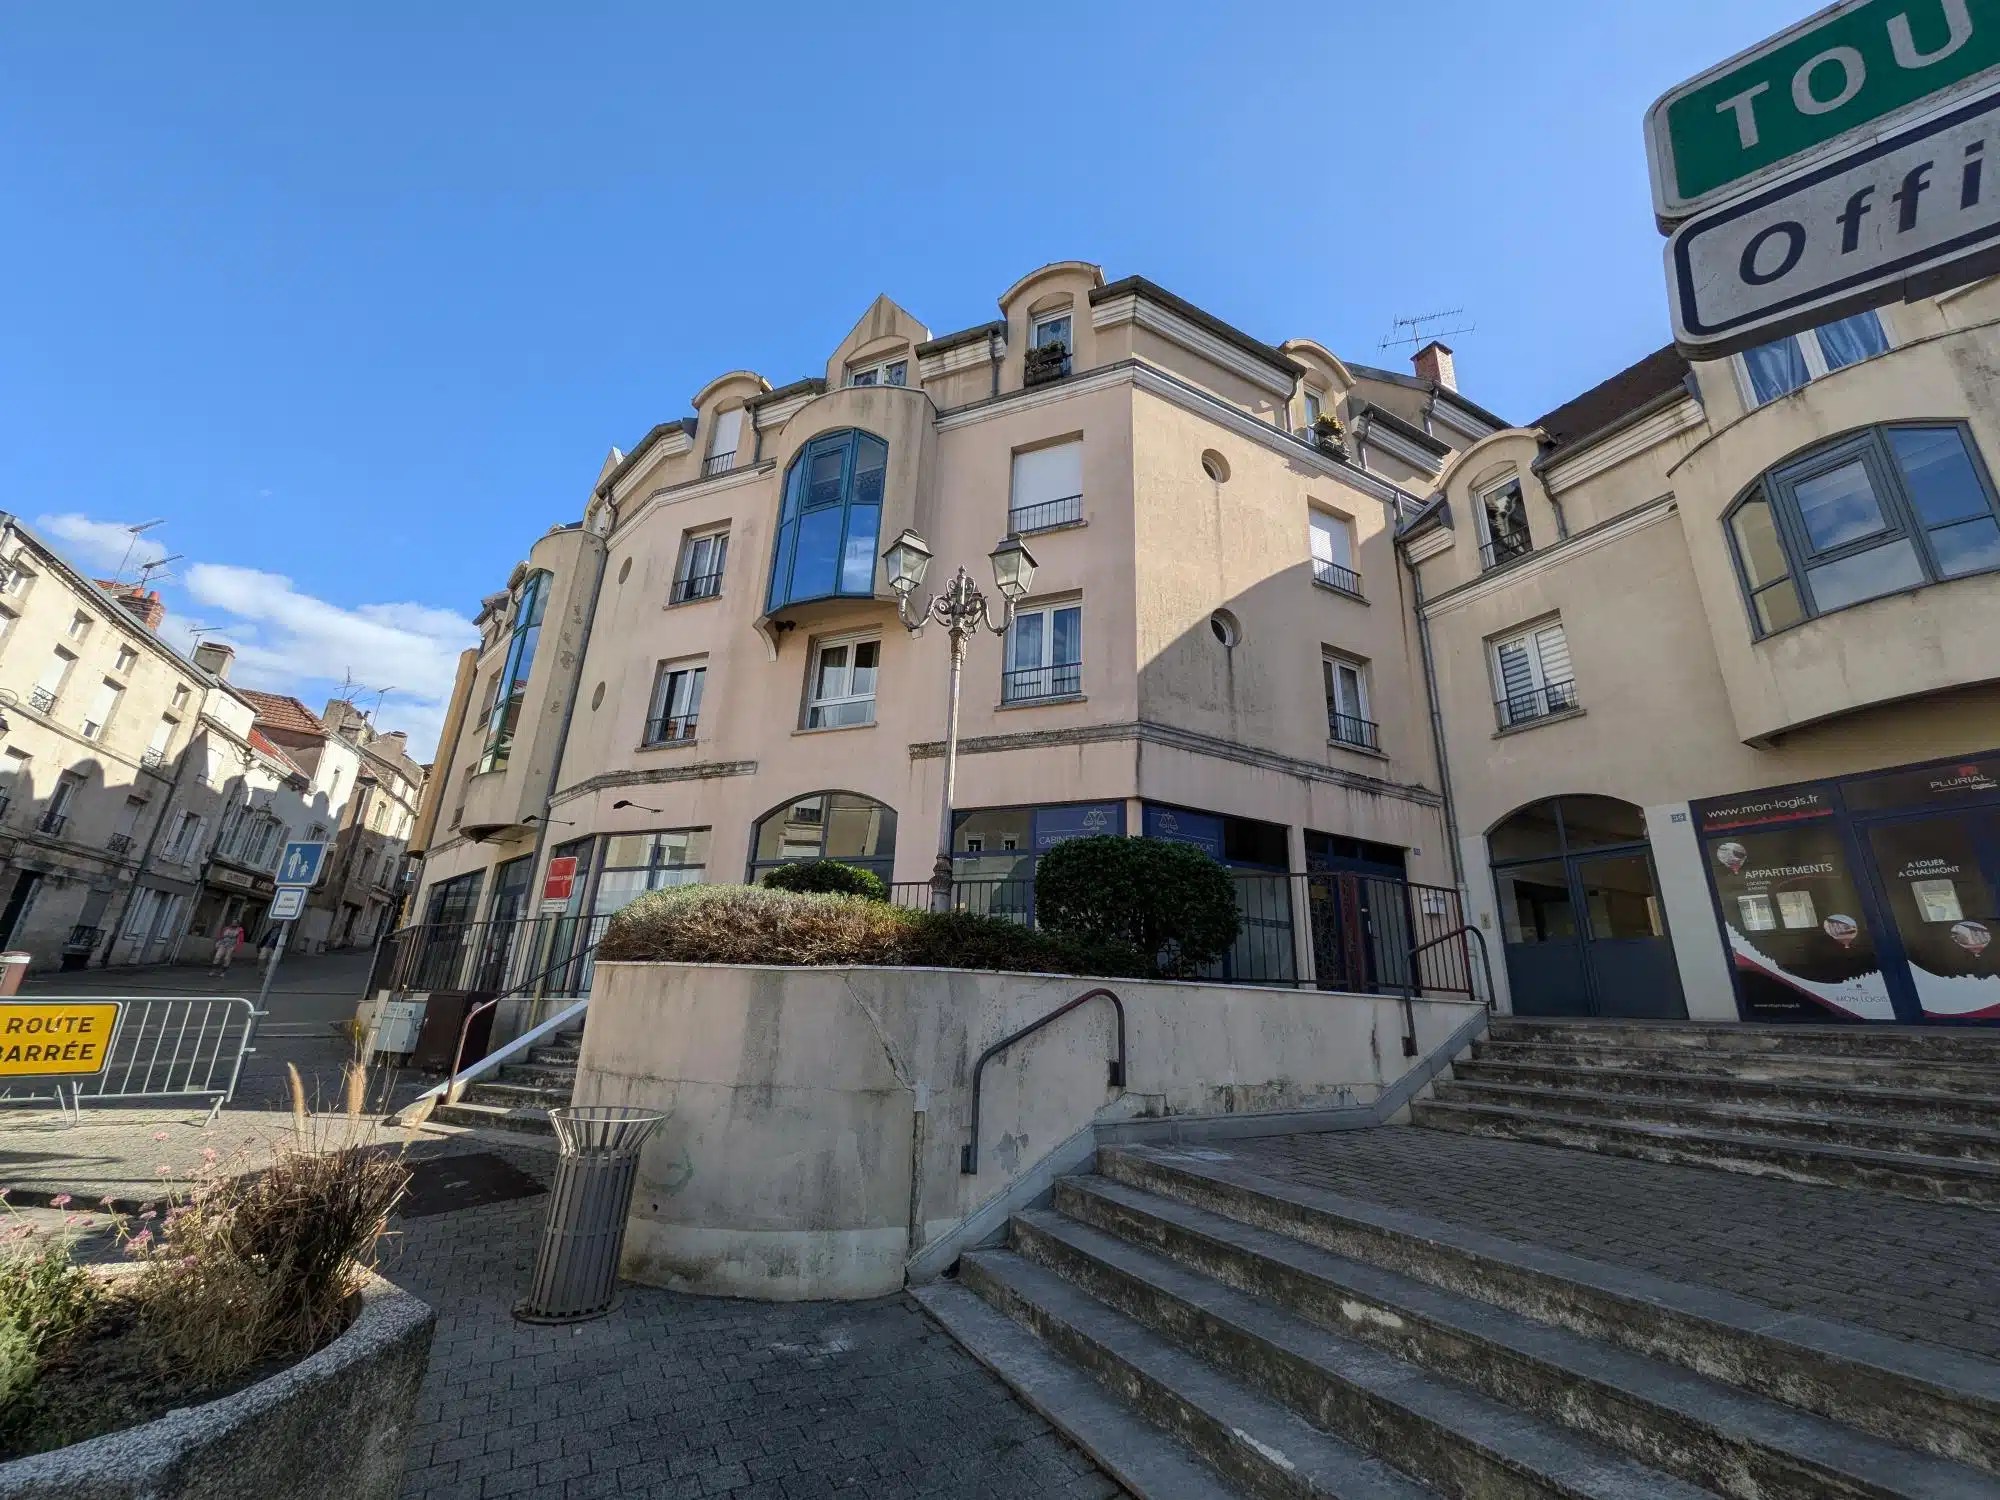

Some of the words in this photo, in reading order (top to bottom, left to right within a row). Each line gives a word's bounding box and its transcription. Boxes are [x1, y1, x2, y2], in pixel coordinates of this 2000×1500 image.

[1715, 0, 1974, 150] TOU
[1738, 139, 1985, 286] Offi
[1930, 774, 1989, 789] PLURIAL
[1707, 794, 1819, 819] www.mon-logis.fr
[1745, 863, 1833, 879] APPARTEMENTS
[1906, 865, 1960, 877] CHAUMONT
[1915, 858, 1945, 868] LOUER
[5, 1016, 95, 1034] ROUTE
